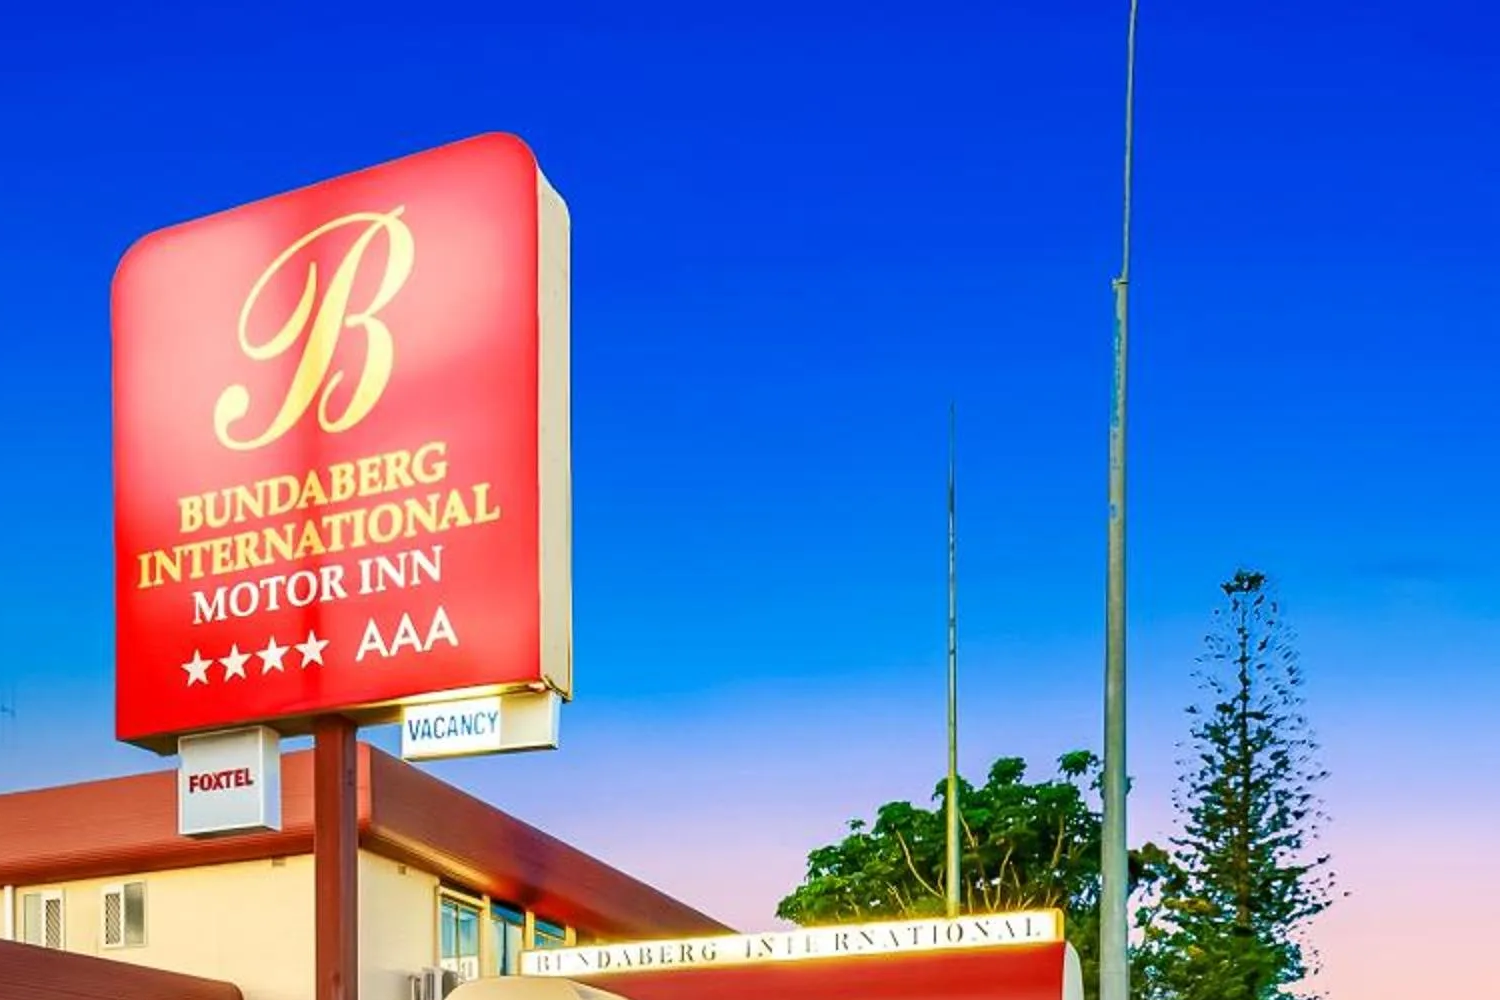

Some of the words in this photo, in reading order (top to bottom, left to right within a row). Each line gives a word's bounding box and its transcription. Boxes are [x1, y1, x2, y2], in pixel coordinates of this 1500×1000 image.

[213, 204, 415, 451] B
[179, 442, 448, 533] BUNDABERG
[137, 483, 500, 588] INTERNATIONAL
[192, 564, 348, 625] MOTOR
[358, 545, 443, 595] INN
[355, 605, 459, 662] AAA
[408, 710, 499, 741] VACANCY
[189, 767, 254, 793] FOXTEL
[536, 942, 717, 973] BUNDABERG
[745, 917, 1042, 959] INTERNATIONAL
